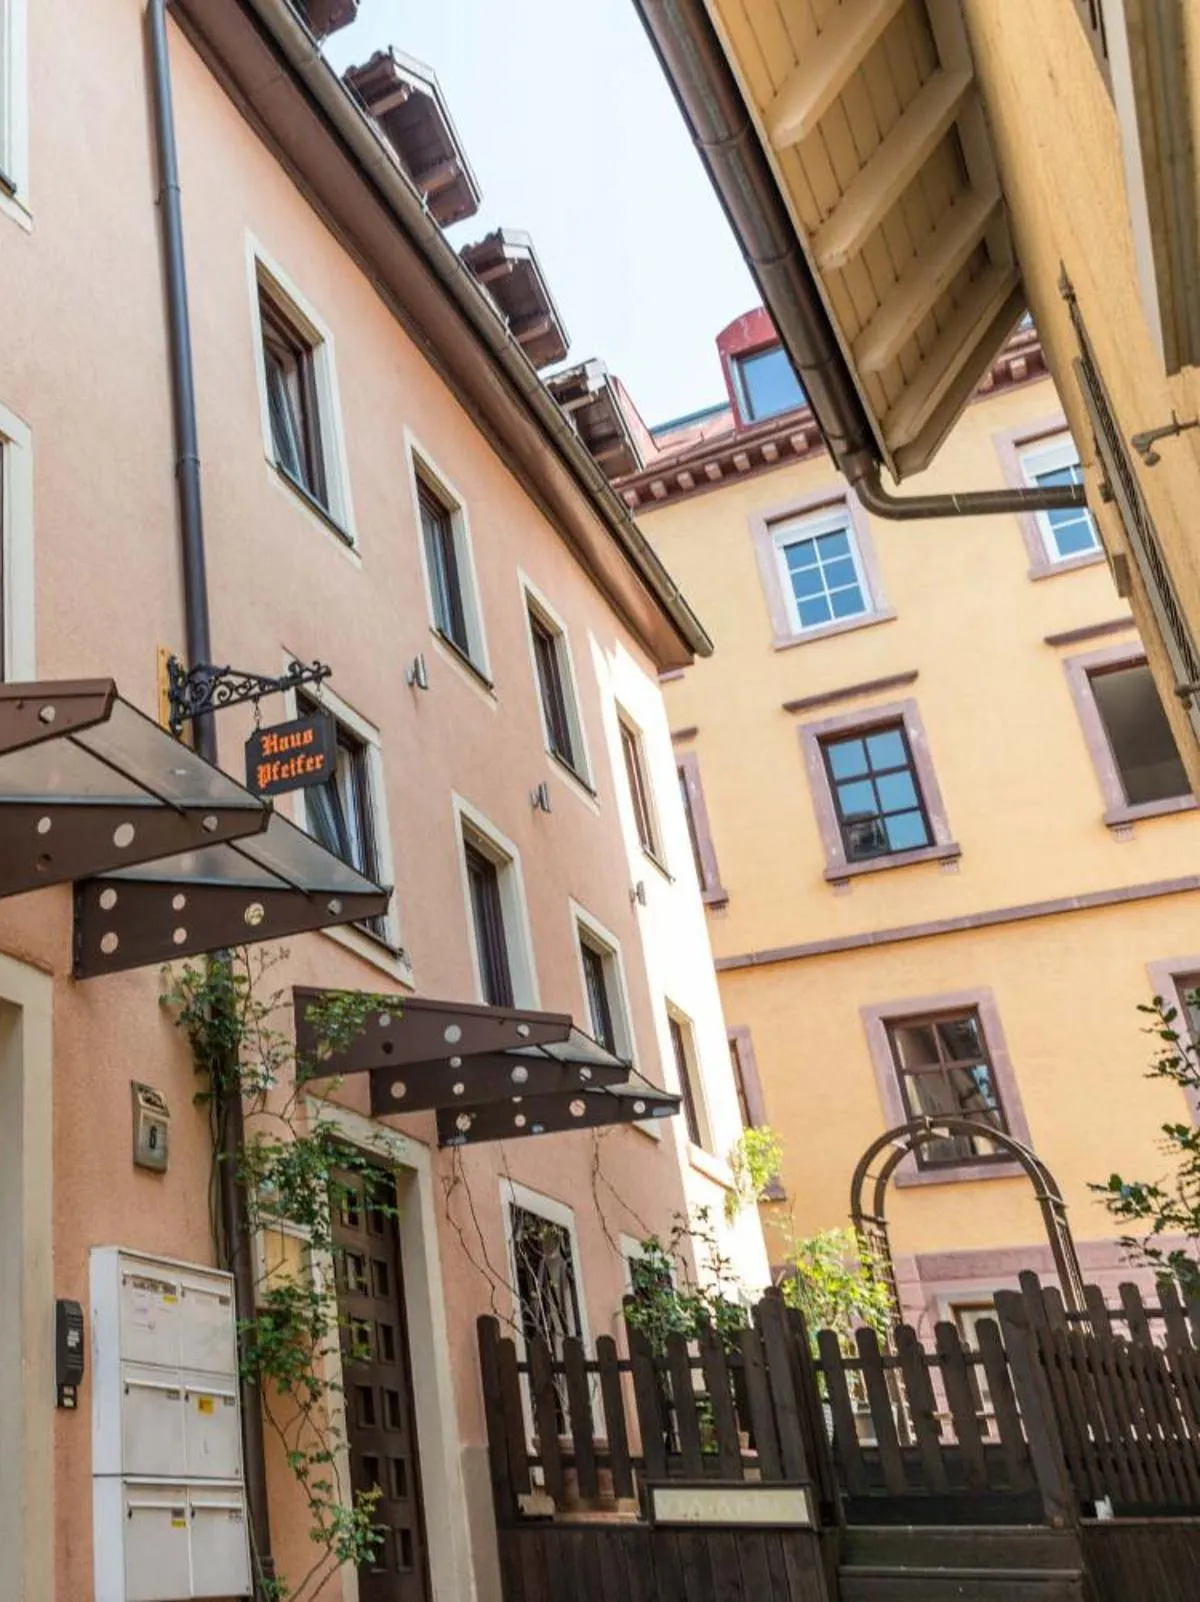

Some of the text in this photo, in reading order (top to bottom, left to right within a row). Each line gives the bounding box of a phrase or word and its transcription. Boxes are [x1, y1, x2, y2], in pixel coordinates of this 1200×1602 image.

[262, 729, 313, 757] Haus
[257, 754, 324, 788] Pfeifer
[149, 1126, 157, 1150] 6
